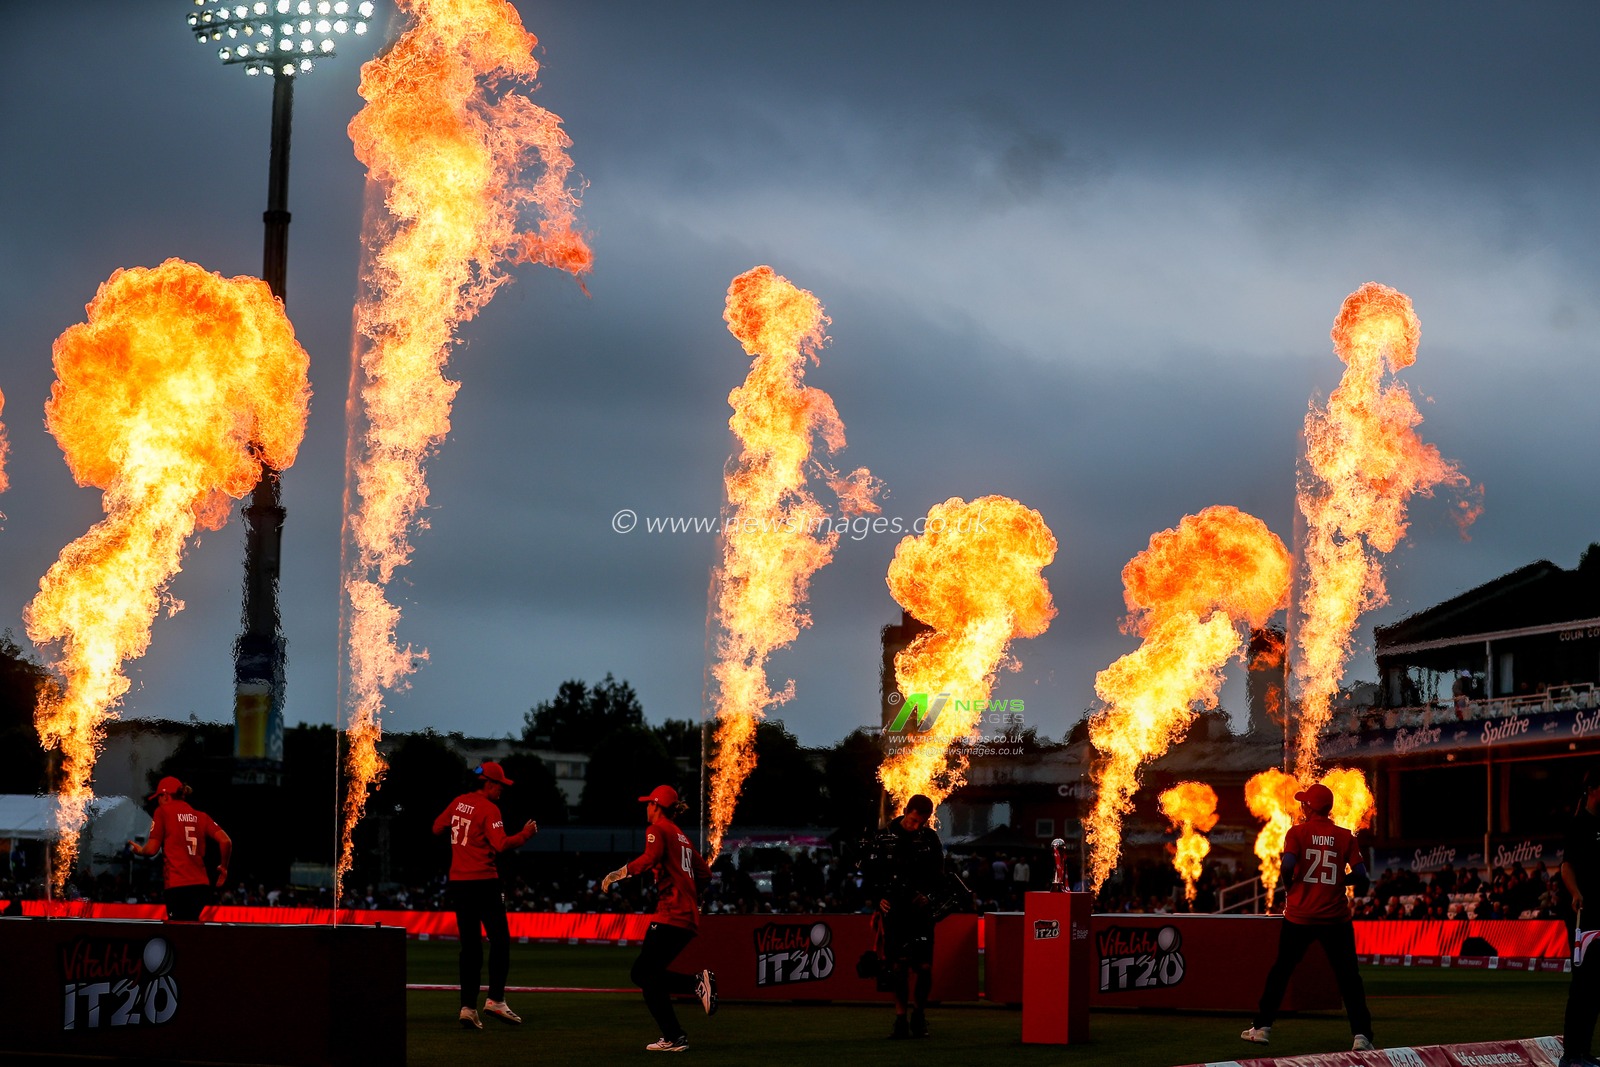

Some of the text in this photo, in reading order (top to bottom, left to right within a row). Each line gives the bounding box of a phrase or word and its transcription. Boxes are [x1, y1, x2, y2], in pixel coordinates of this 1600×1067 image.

[1480, 715, 1529, 744] Spitfire
[184, 826, 197, 856] 5
[451, 815, 471, 847] 37
[1312, 835, 1335, 846] WONG
[1303, 848, 1337, 885] 25
[1411, 845, 1456, 871] Spitfire
[1494, 841, 1543, 867] Spitfire
[757, 925, 810, 957] Vitality
[1100, 927, 1157, 960] Vitality
[63, 938, 142, 990] Vitality
[1472, 1050, 1522, 1065] insurance
